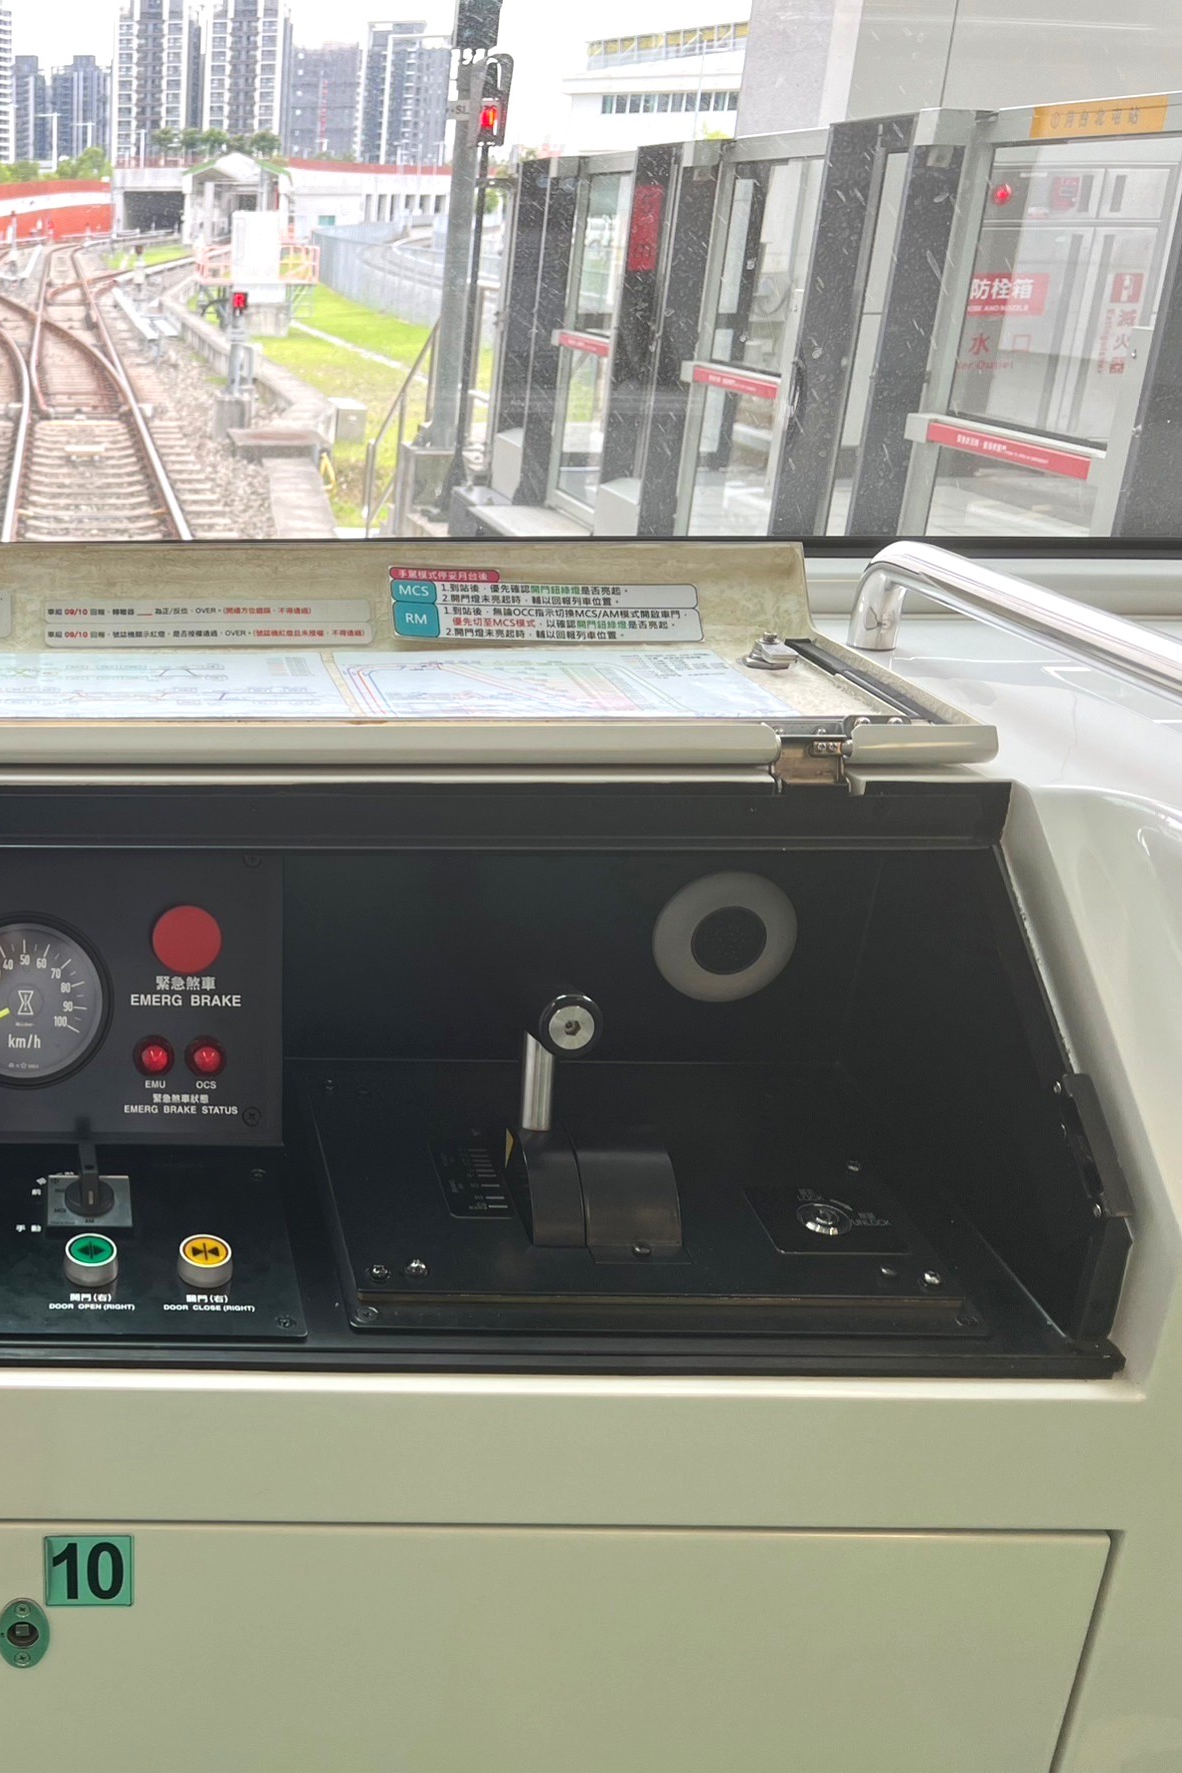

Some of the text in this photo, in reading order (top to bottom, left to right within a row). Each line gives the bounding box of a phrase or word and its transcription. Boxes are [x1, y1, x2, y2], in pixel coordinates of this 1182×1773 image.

[399, 585, 429, 596] MCS
[64, 608, 88, 616] 09/10
[405, 613, 428, 624] RM
[64, 631, 88, 639] 09/10
[3, 959, 14, 970] 40
[20, 954, 30, 965] 50
[36, 958, 47, 969] 60
[51, 968, 61, 979] 70
[60, 982, 71, 993] 80
[156, 976, 216, 991] 緊急煞車
[130, 994, 242, 1007] EMERG BRAKE
[63, 1001, 73, 1012] 90
[54, 1016, 67, 1027] 100
[8, 1034, 41, 1048] km/h
[145, 1080, 166, 1089] EMU
[196, 1080, 217, 1089] OCS
[152, 1093, 209, 1104] 緊急煞車狀態
[124, 1105, 238, 1115] EMERG BRAKE STATUS
[69, 1293, 112, 1302] 開門(右)
[103, 1303, 135, 1311] (RIGHT)
[52, 1541, 124, 1600] 10
